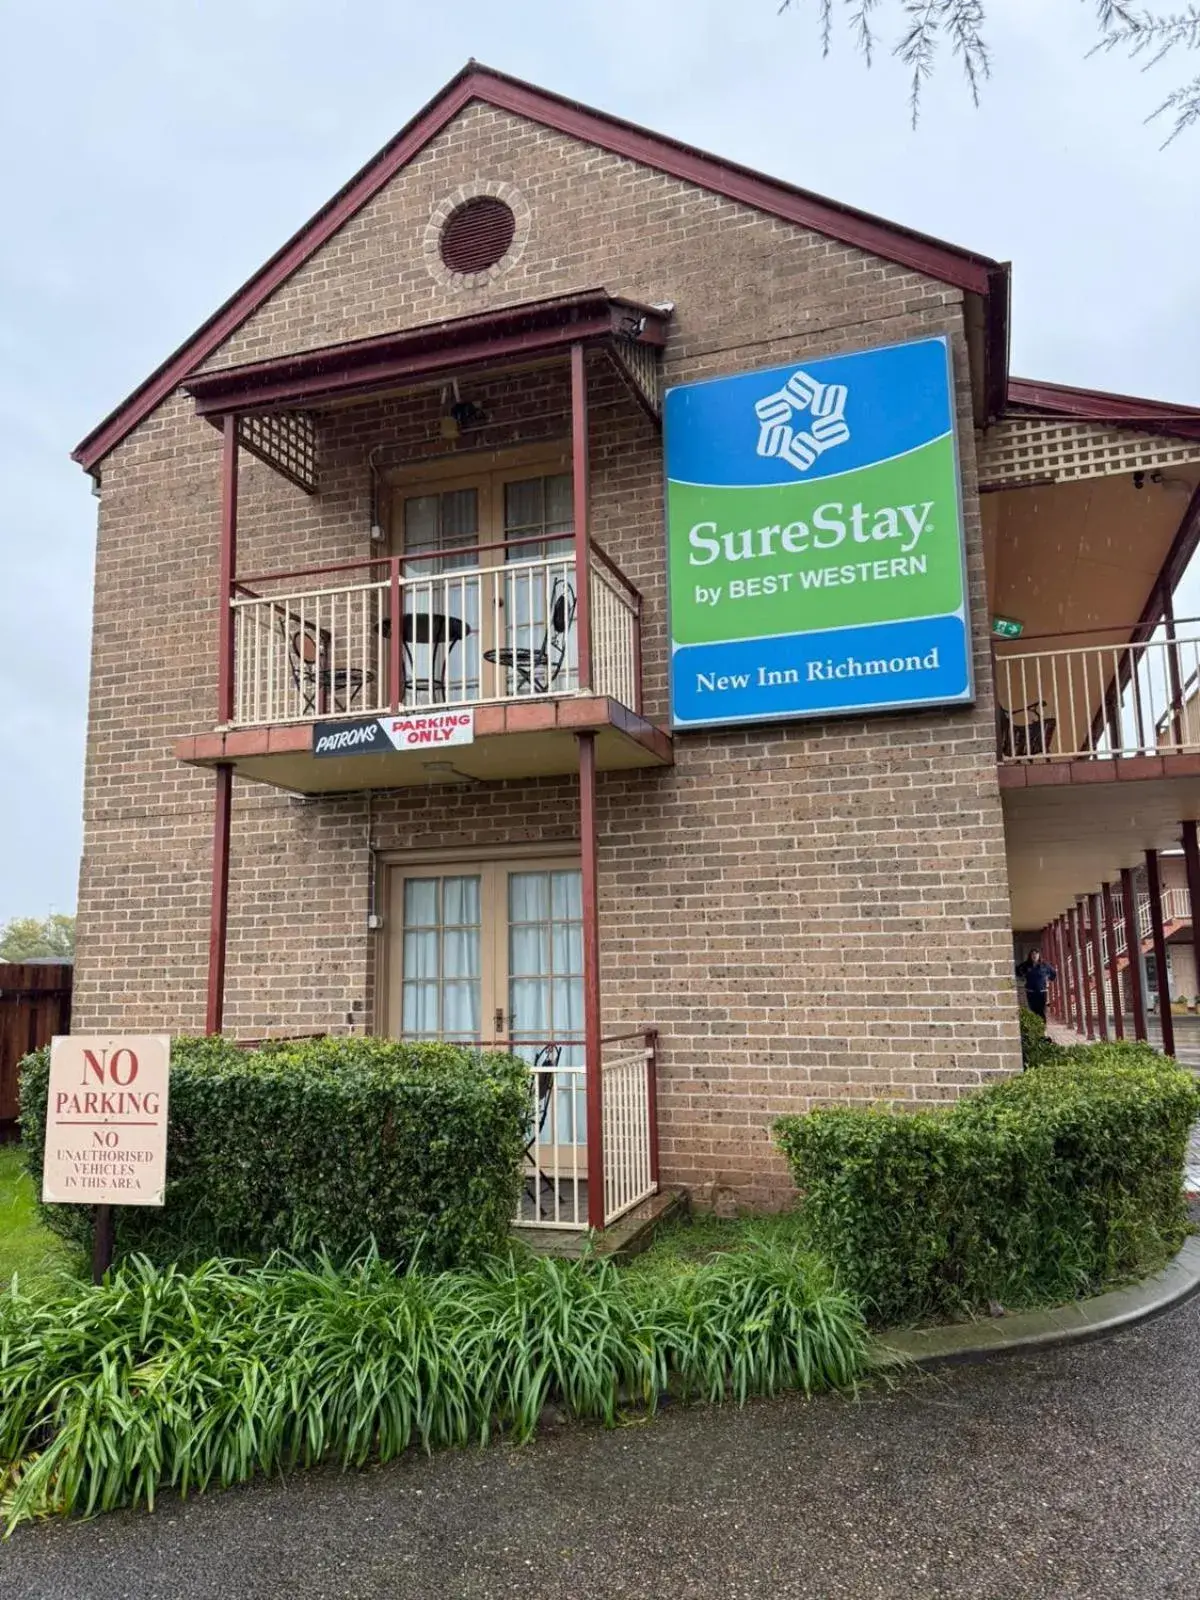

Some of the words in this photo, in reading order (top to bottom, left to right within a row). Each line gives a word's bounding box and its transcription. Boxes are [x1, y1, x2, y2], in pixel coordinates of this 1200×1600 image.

[688, 500, 934, 566] SureStay
[695, 584, 721, 606] by
[729, 572, 793, 599] BEST
[800, 554, 928, 589] WESTERN
[696, 671, 749, 693] New
[757, 666, 799, 687] Inn
[805, 647, 940, 682] Richmond
[392, 714, 470, 732] PARKING
[316, 724, 377, 752] PATRONS
[407, 728, 454, 744] ONLY
[80, 1048, 138, 1086] NO
[56, 1092, 159, 1115] PARKING
[92, 1131, 119, 1148] NO
[57, 1150, 153, 1163] UNAUTHORISED
[74, 1163, 135, 1175] VEHICLES
[65, 1176, 77, 1188] IN
[81, 1176, 107, 1188] THIS
[110, 1177, 141, 1189] AREA
